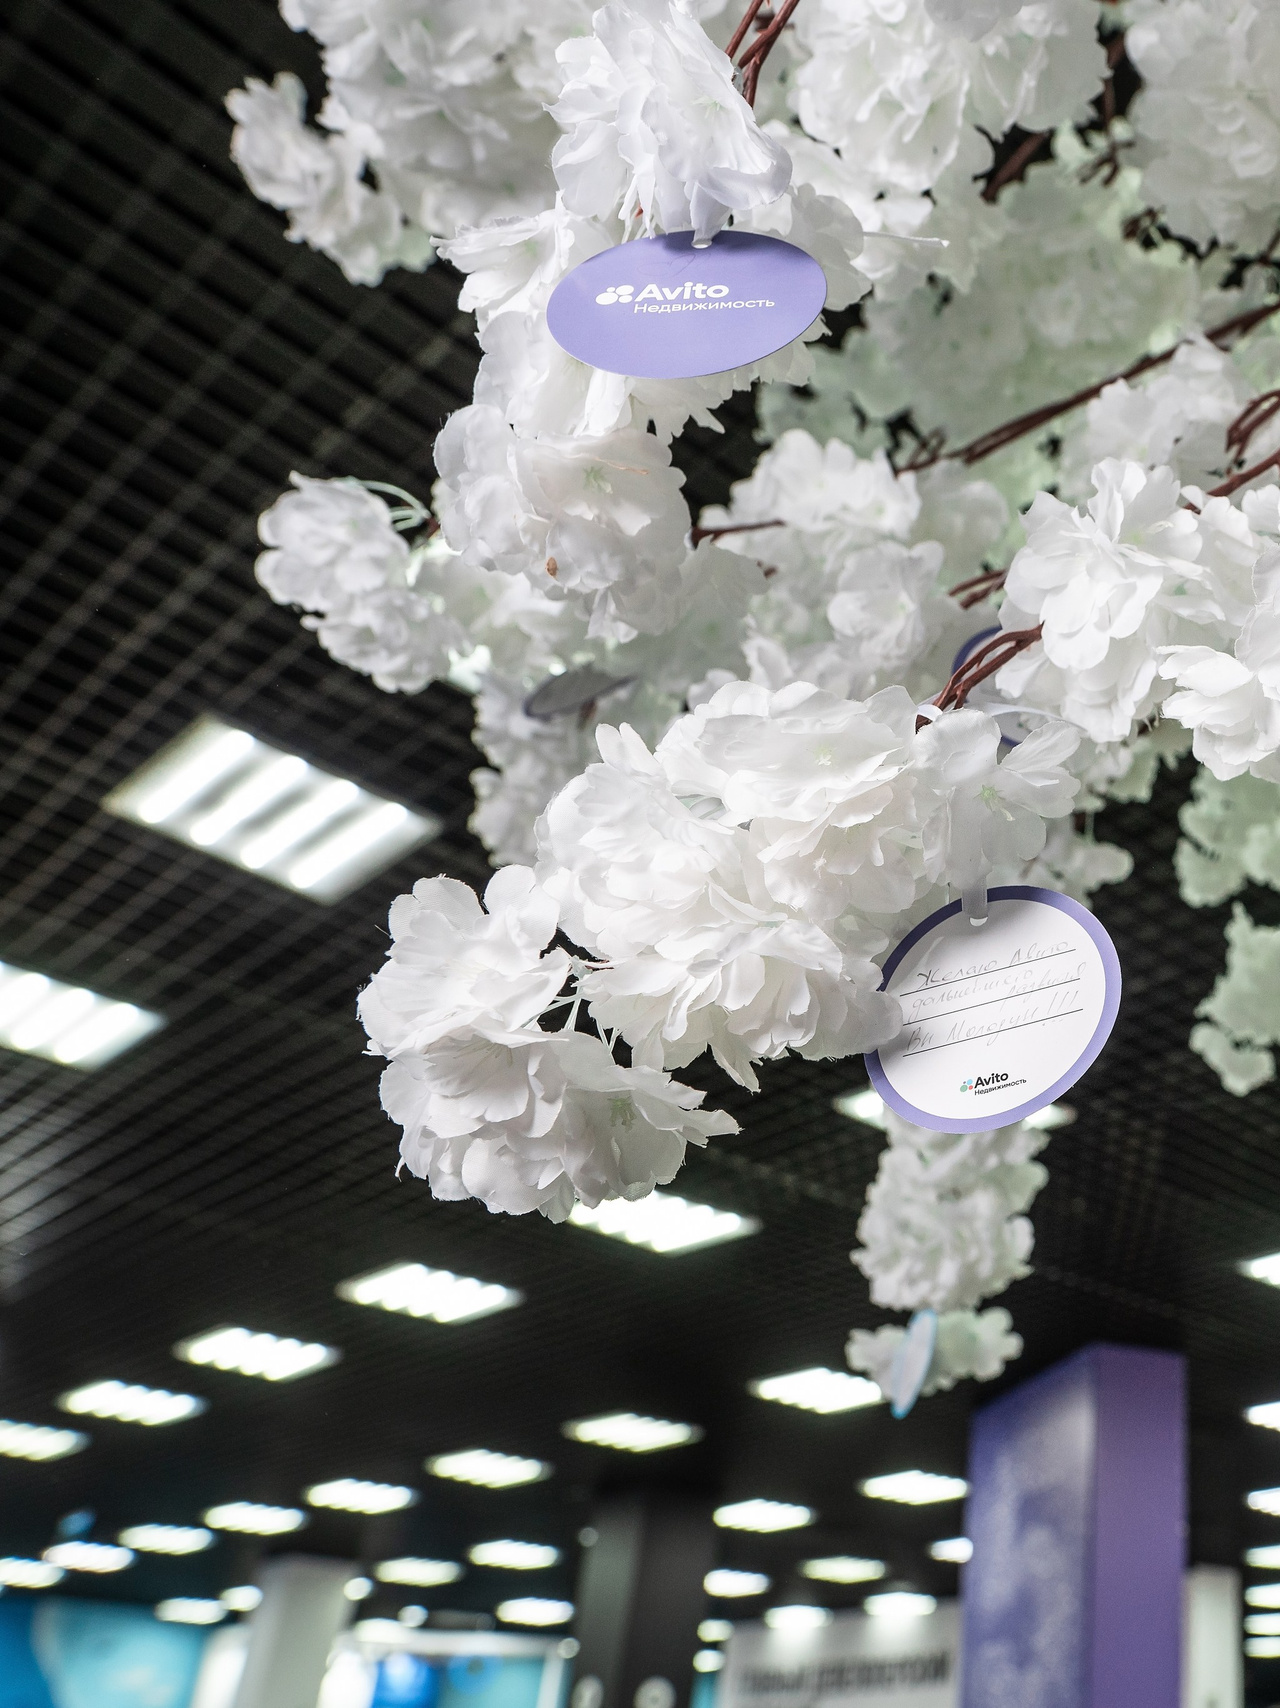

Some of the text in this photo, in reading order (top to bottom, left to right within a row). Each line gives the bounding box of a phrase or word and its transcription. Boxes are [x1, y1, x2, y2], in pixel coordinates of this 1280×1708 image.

[635, 281, 730, 302] Avito
[633, 298, 775, 314] Недвижимость
[917, 960, 998, 989] Желаю
[974, 1071, 1009, 1089] Avito
[974, 1078, 1027, 1096] Недвижимость
